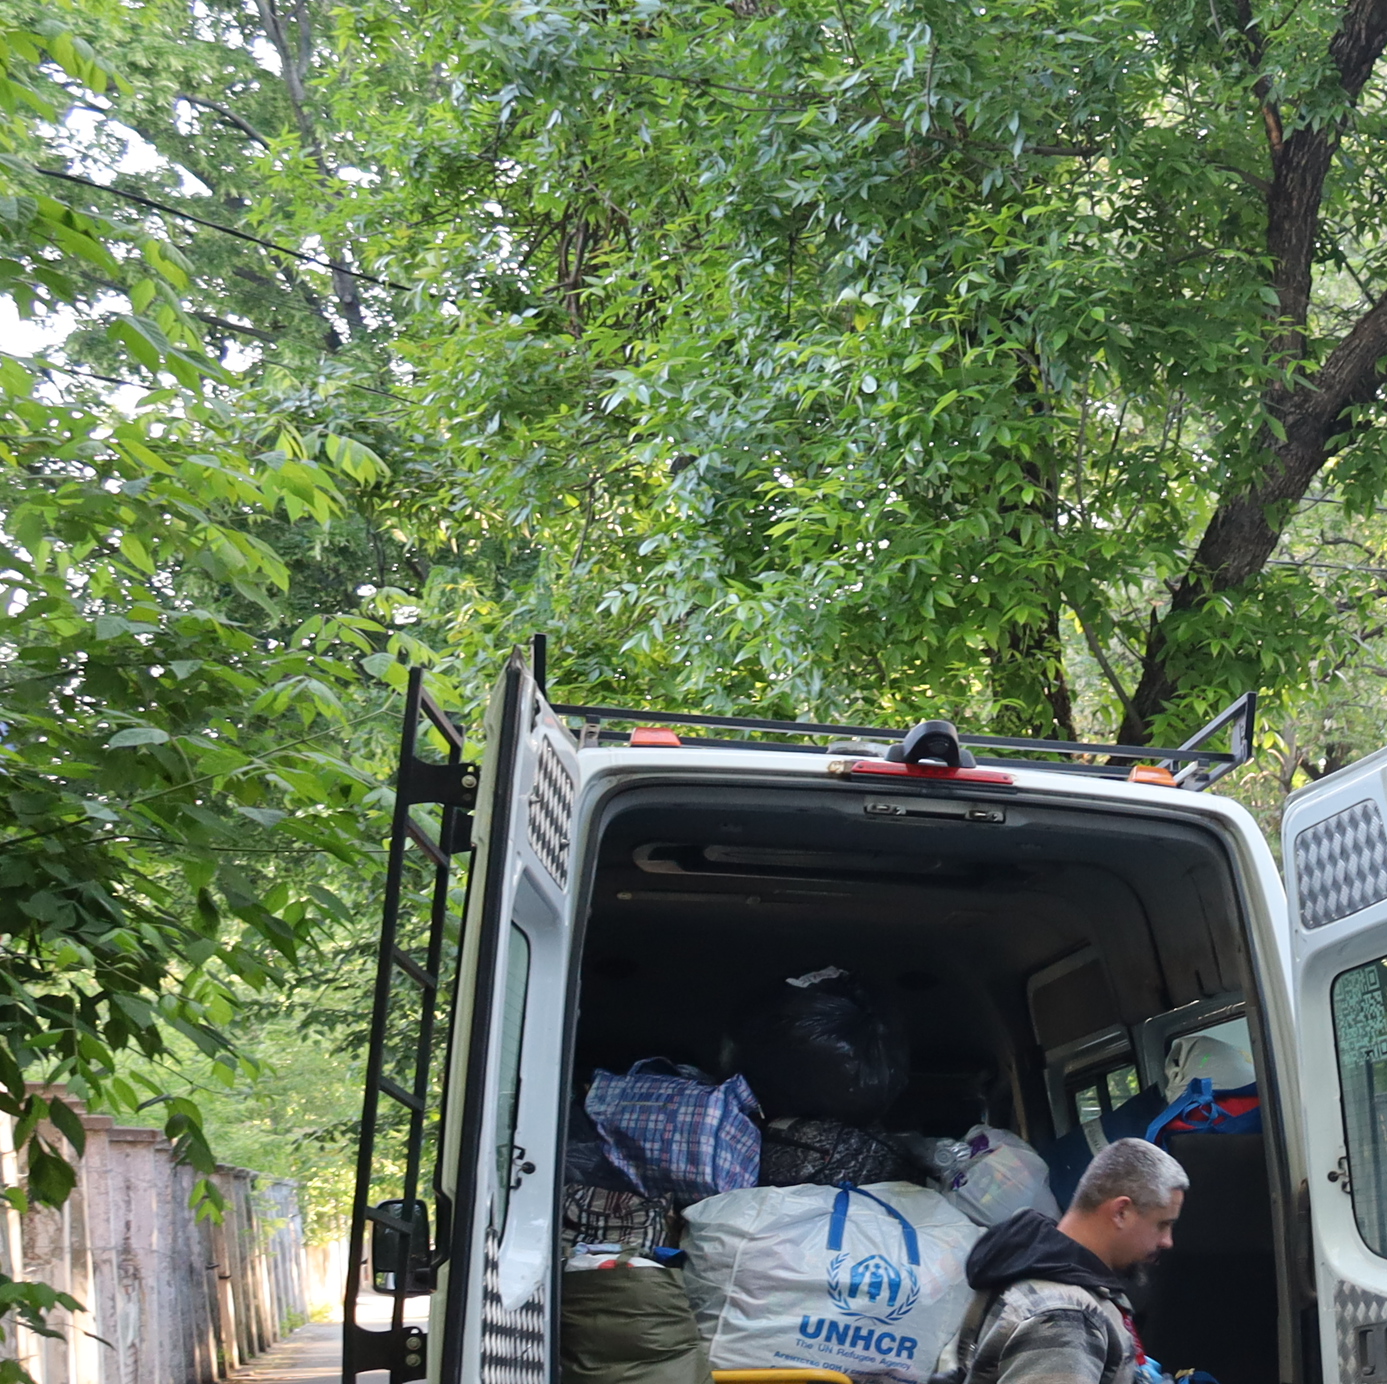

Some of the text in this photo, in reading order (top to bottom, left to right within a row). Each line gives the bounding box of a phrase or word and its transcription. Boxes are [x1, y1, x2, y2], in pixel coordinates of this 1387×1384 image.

[795, 1337, 912, 1372] The UN Refugee Agency
[799, 1314, 918, 1360] UNHCR
